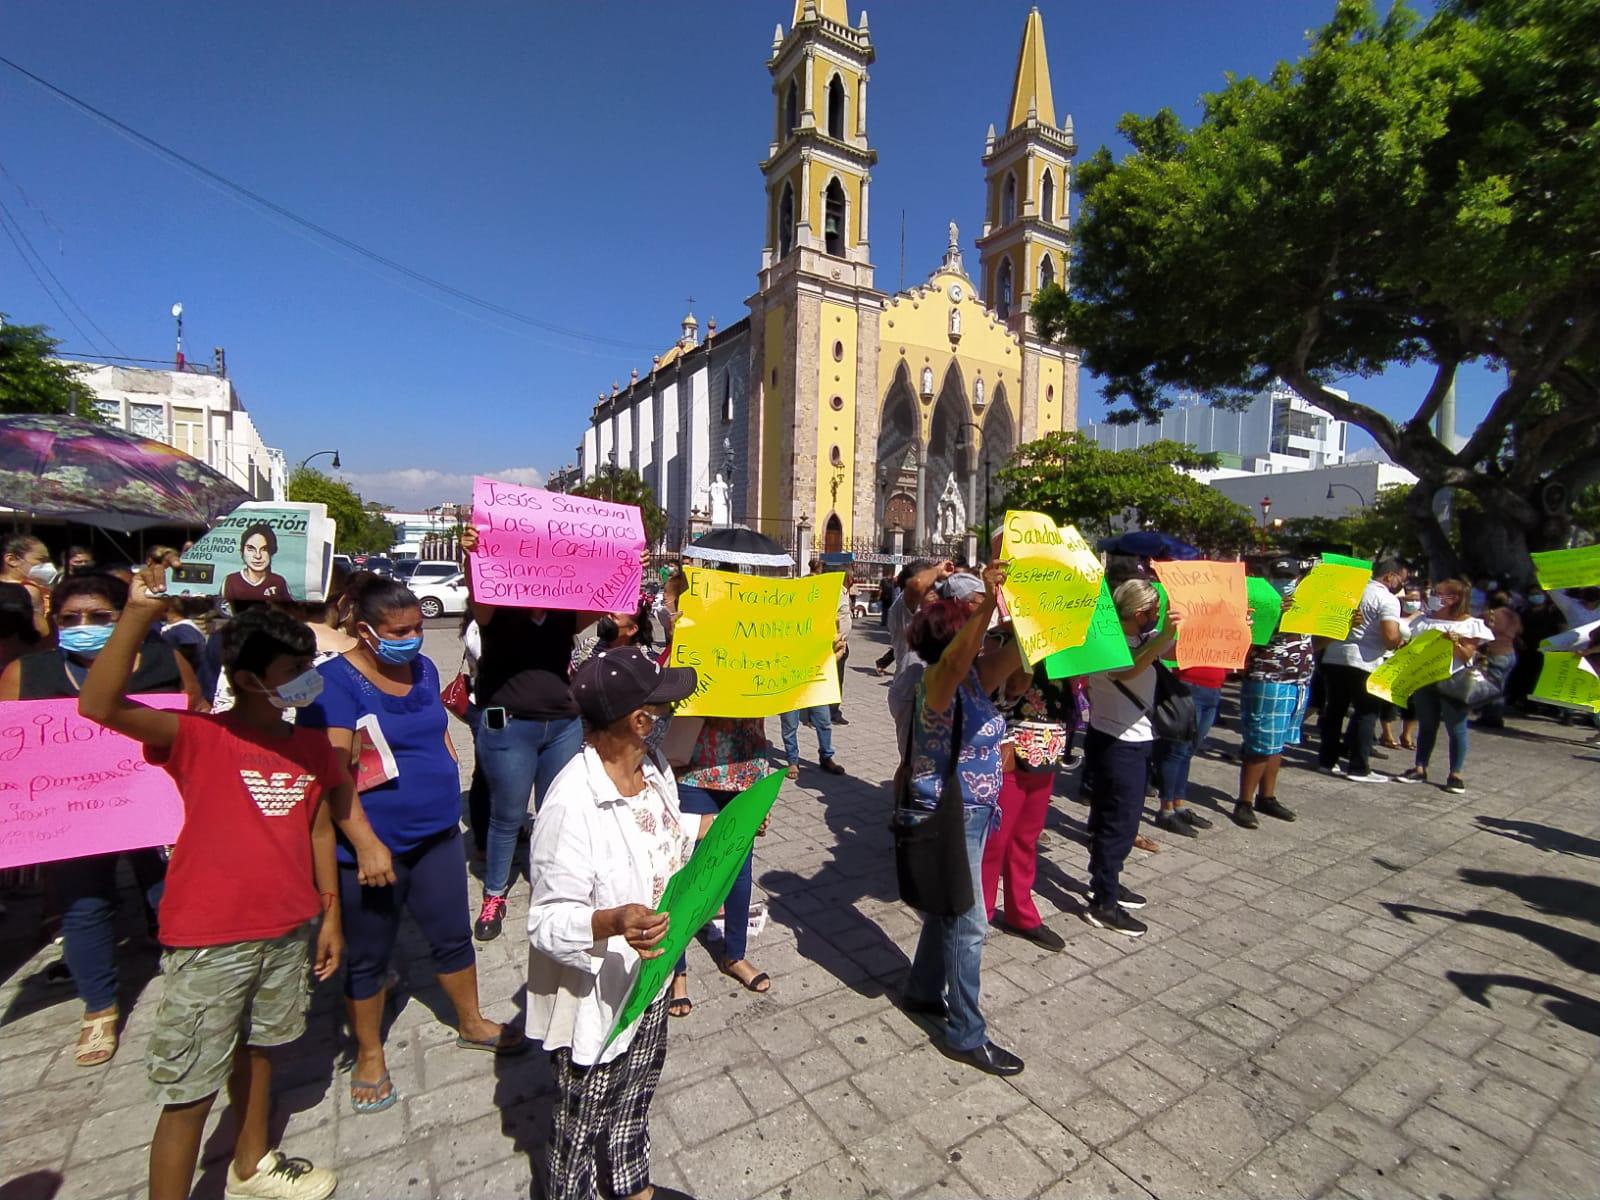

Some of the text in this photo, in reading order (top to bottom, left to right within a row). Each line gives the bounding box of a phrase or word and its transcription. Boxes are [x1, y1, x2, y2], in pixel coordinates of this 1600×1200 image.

[482, 482, 631, 522] Jesús Sandoval
[488, 512, 637, 541] Las personas
[212, 537, 237, 545] PARA
[476, 537, 630, 561] de El Castillo
[478, 560, 577, 579] Estamos
[263, 586, 277, 597] 4T
[480, 579, 594, 600] Sorprendidas
[690, 572, 709, 598] El
[724, 581, 795, 606] Traidor
[676, 644, 702, 666] Es
